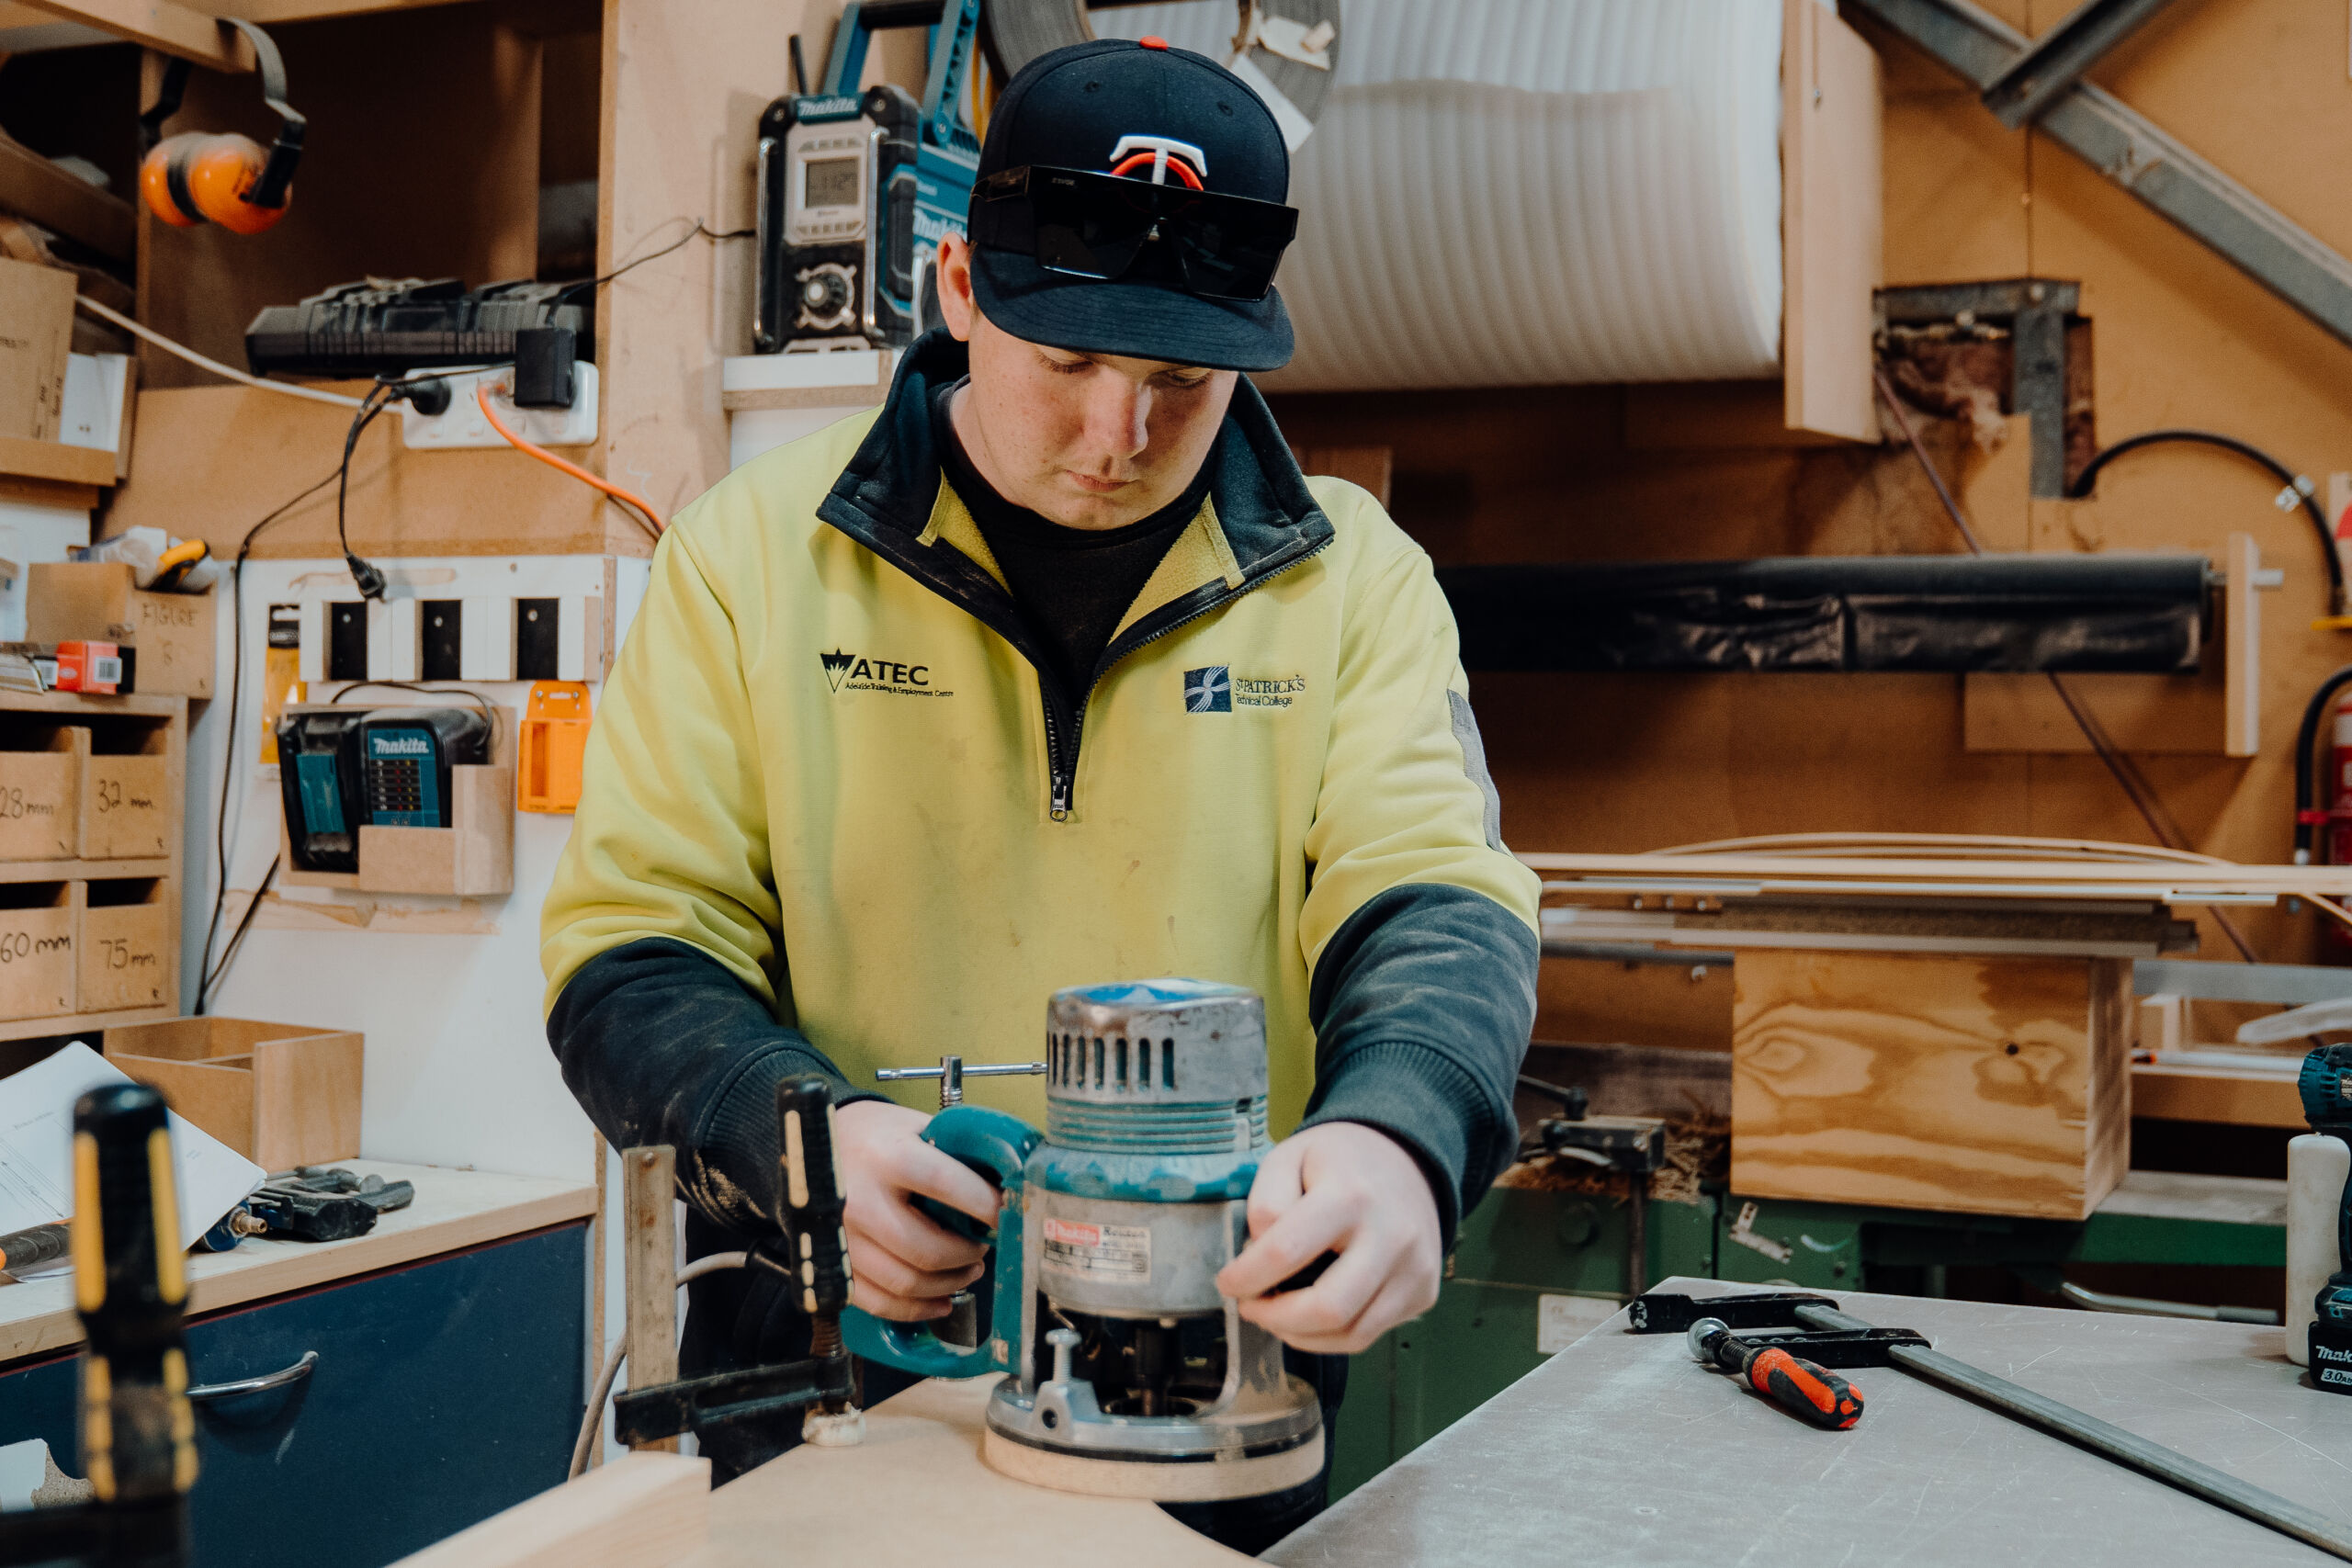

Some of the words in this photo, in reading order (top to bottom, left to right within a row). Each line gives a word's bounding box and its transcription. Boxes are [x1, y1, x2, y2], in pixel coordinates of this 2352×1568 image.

[850, 658, 929, 686] ATEC
[898, 686, 933, 696] Employment
[1261, 695, 1293, 707] College
[98, 778, 121, 813] 32
[1, 931, 30, 964] 60
